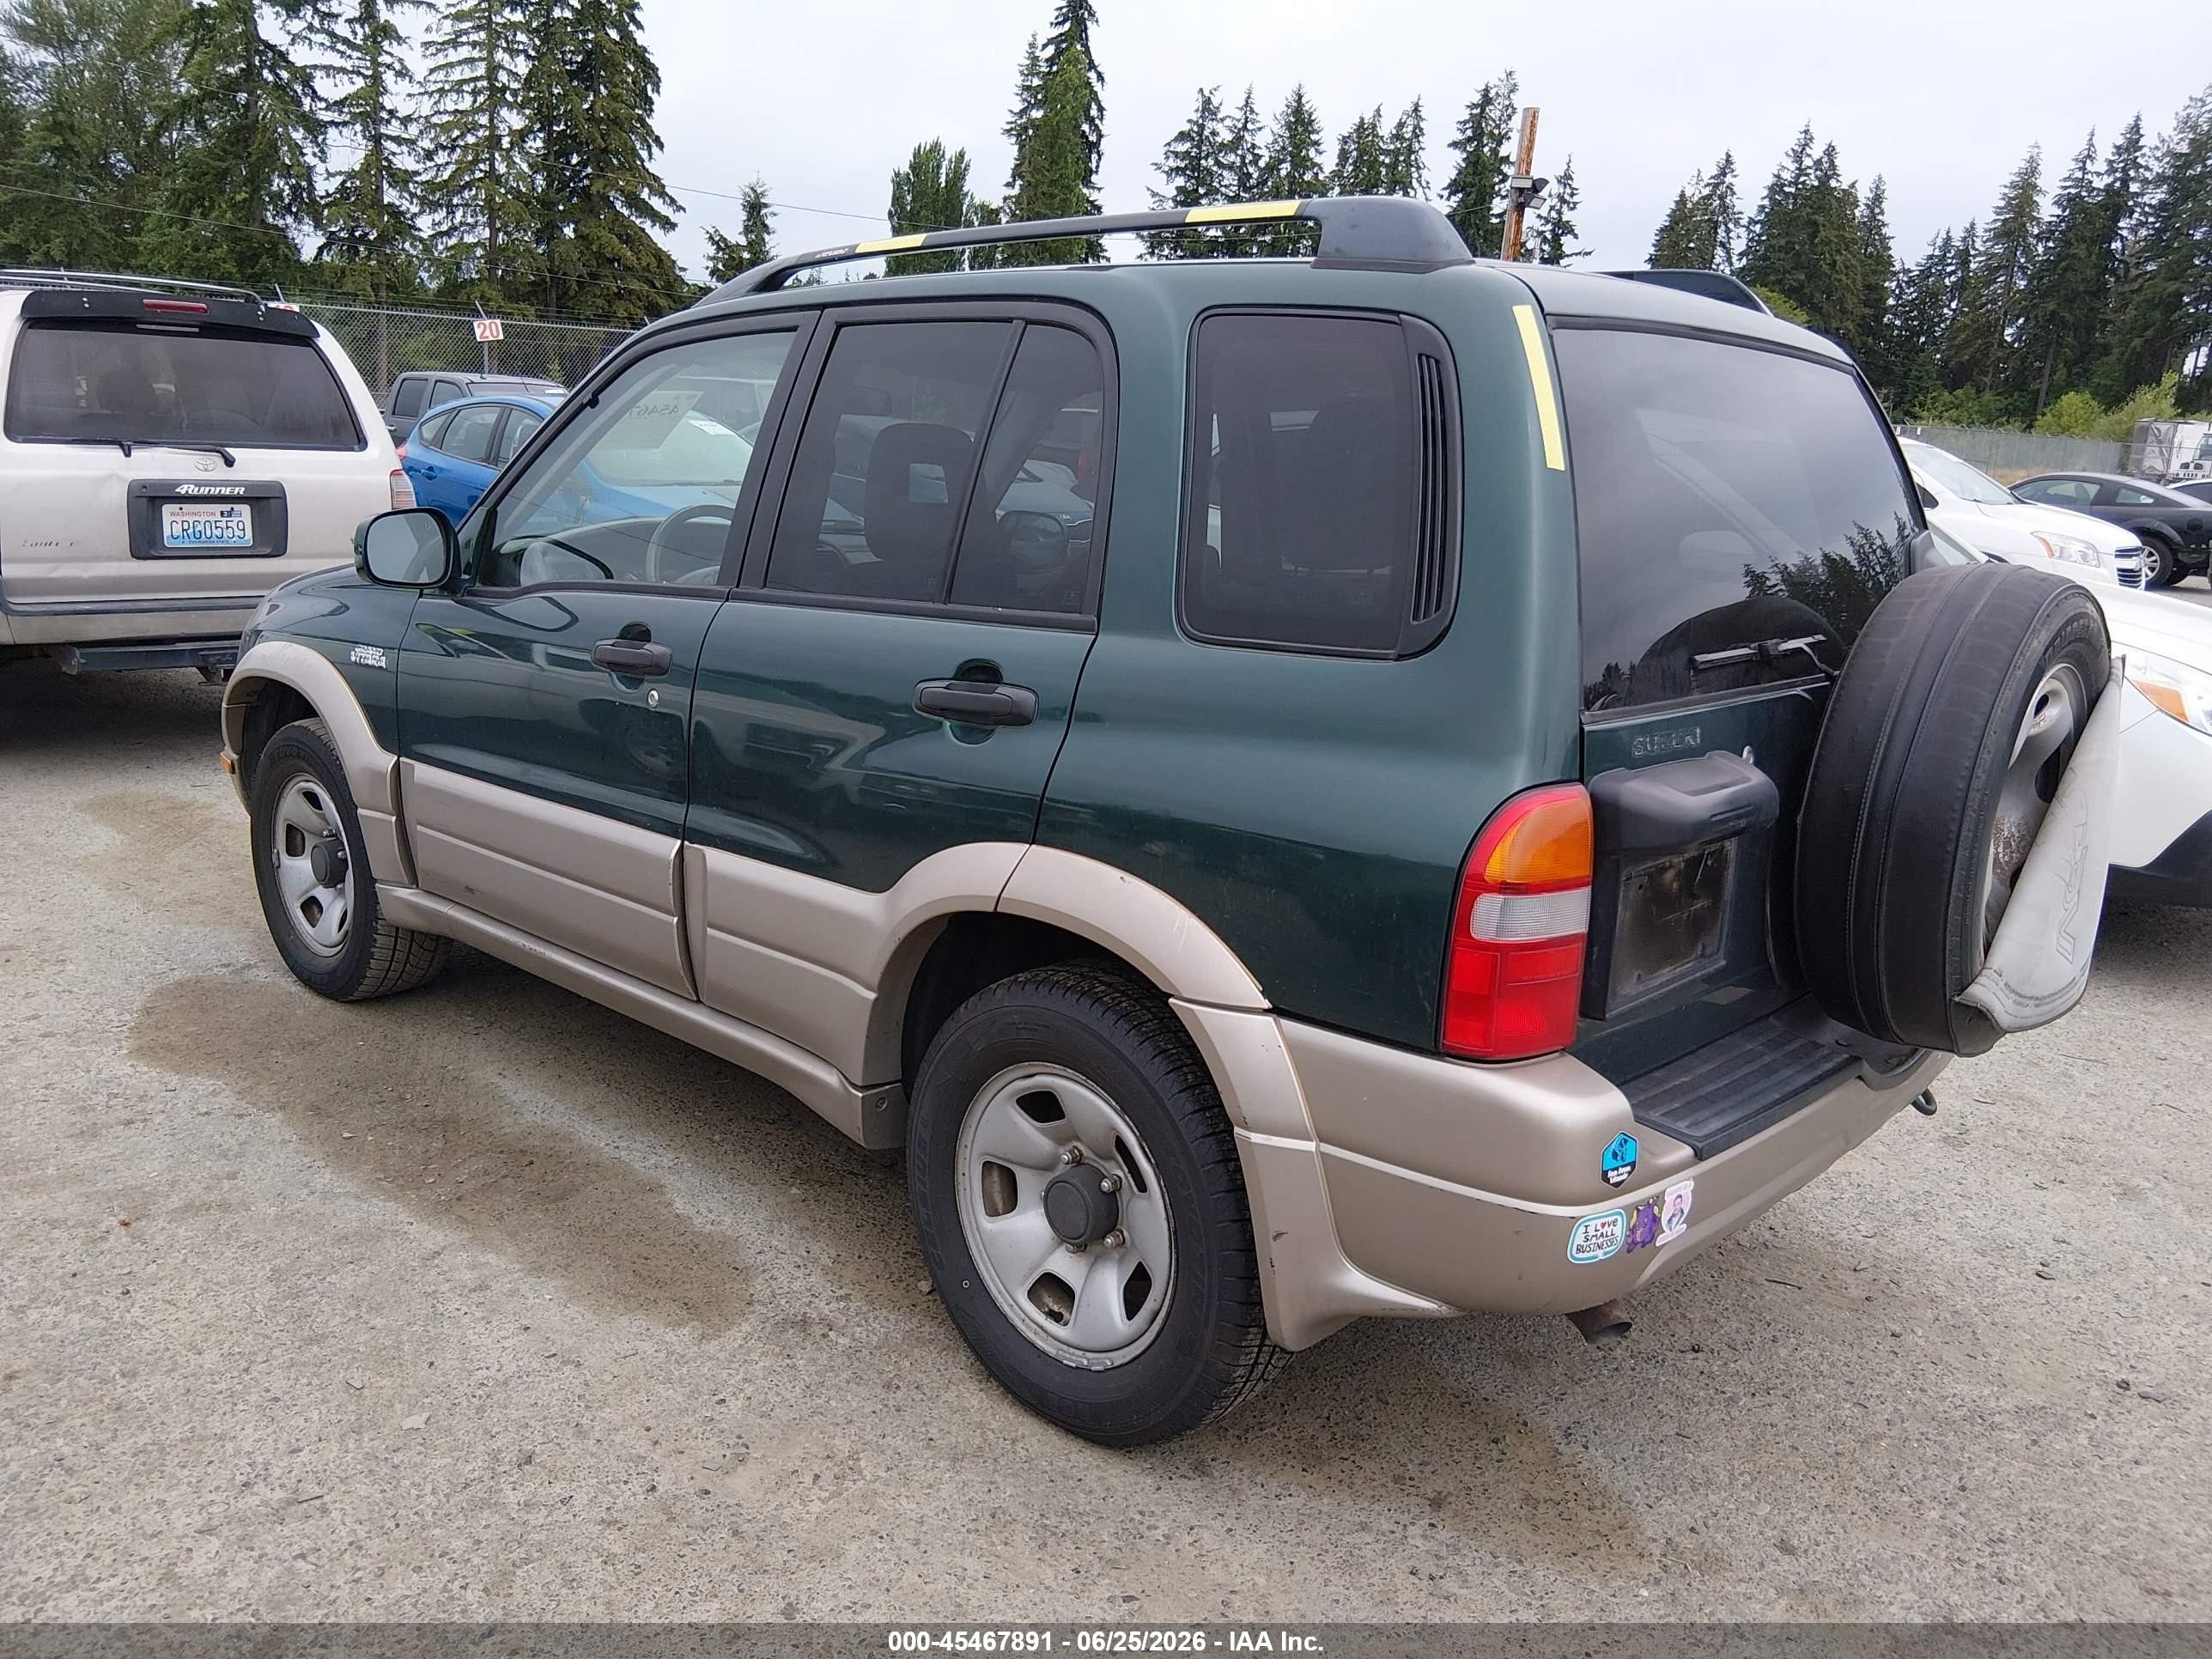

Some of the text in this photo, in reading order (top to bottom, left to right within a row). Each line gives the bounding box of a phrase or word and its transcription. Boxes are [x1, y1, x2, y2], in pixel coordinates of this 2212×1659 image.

[477, 321, 501, 339] 20
[170, 520, 246, 540] CRG0559
[1632, 727, 1701, 757] SUZUKI
[1583, 1224, 1590, 1235] I
[1583, 1229, 1616, 1243] SMALL
[1576, 1236, 1620, 1255] BUSINESSES
